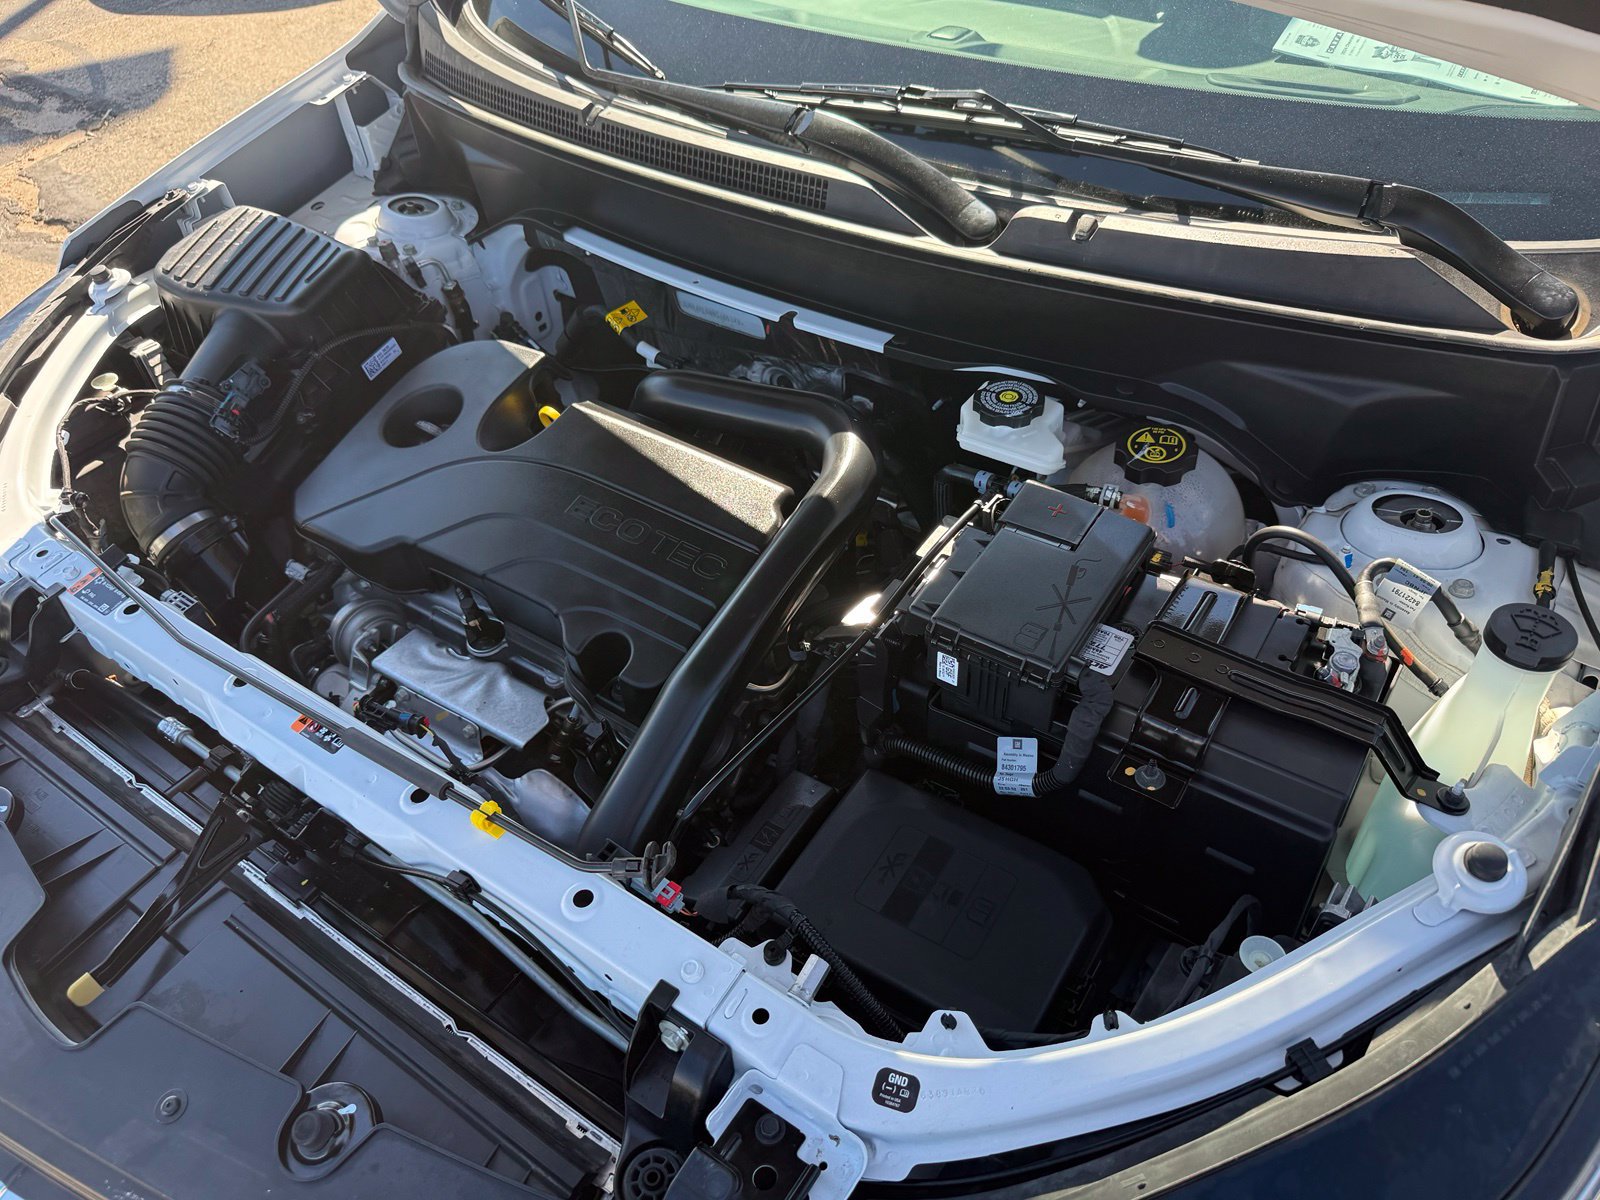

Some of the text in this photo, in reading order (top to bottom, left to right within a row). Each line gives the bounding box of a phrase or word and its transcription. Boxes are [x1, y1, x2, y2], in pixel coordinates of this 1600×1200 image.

[564, 495, 728, 580] ECOTEC
[1391, 587, 1421, 607] 84221791
[888, 1072, 909, 1087] GND
